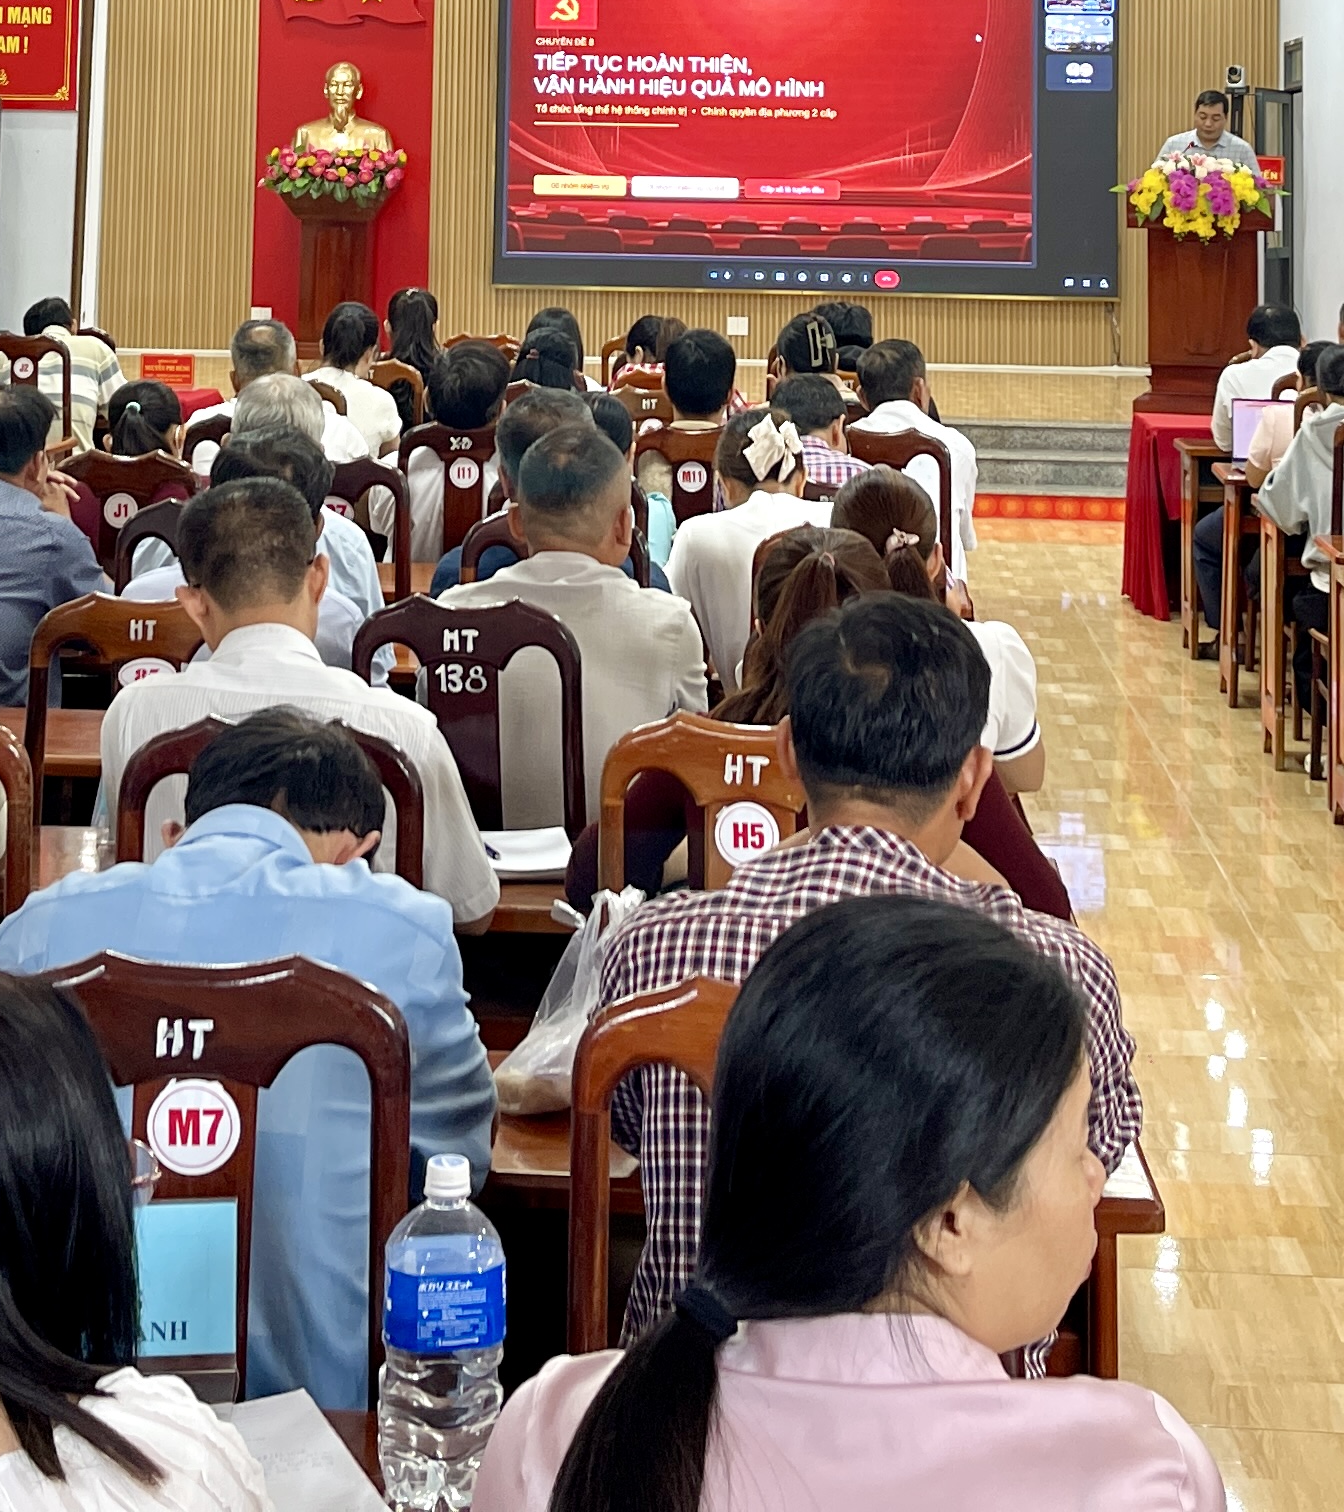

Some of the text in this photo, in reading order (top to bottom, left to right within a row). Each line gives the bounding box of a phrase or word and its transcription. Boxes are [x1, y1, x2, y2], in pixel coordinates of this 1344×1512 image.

[7, 6, 51, 27] MẠNG
[533, 51, 752, 77] TIẾP TỤC HOÀN THIỆN,
[533, 74, 824, 99] VẬN HÀNH HIỆU QUẢ MÔ HÌNH
[682, 471, 702, 483] M11
[114, 504, 127, 517] J1
[130, 620, 156, 640] HT
[442, 628, 480, 654] HT
[434, 664, 488, 693] 138
[724, 753, 771, 786] HT
[732, 820, 766, 850] H5
[155, 1017, 215, 1060] HT
[168, 1108, 224, 1147] M7
